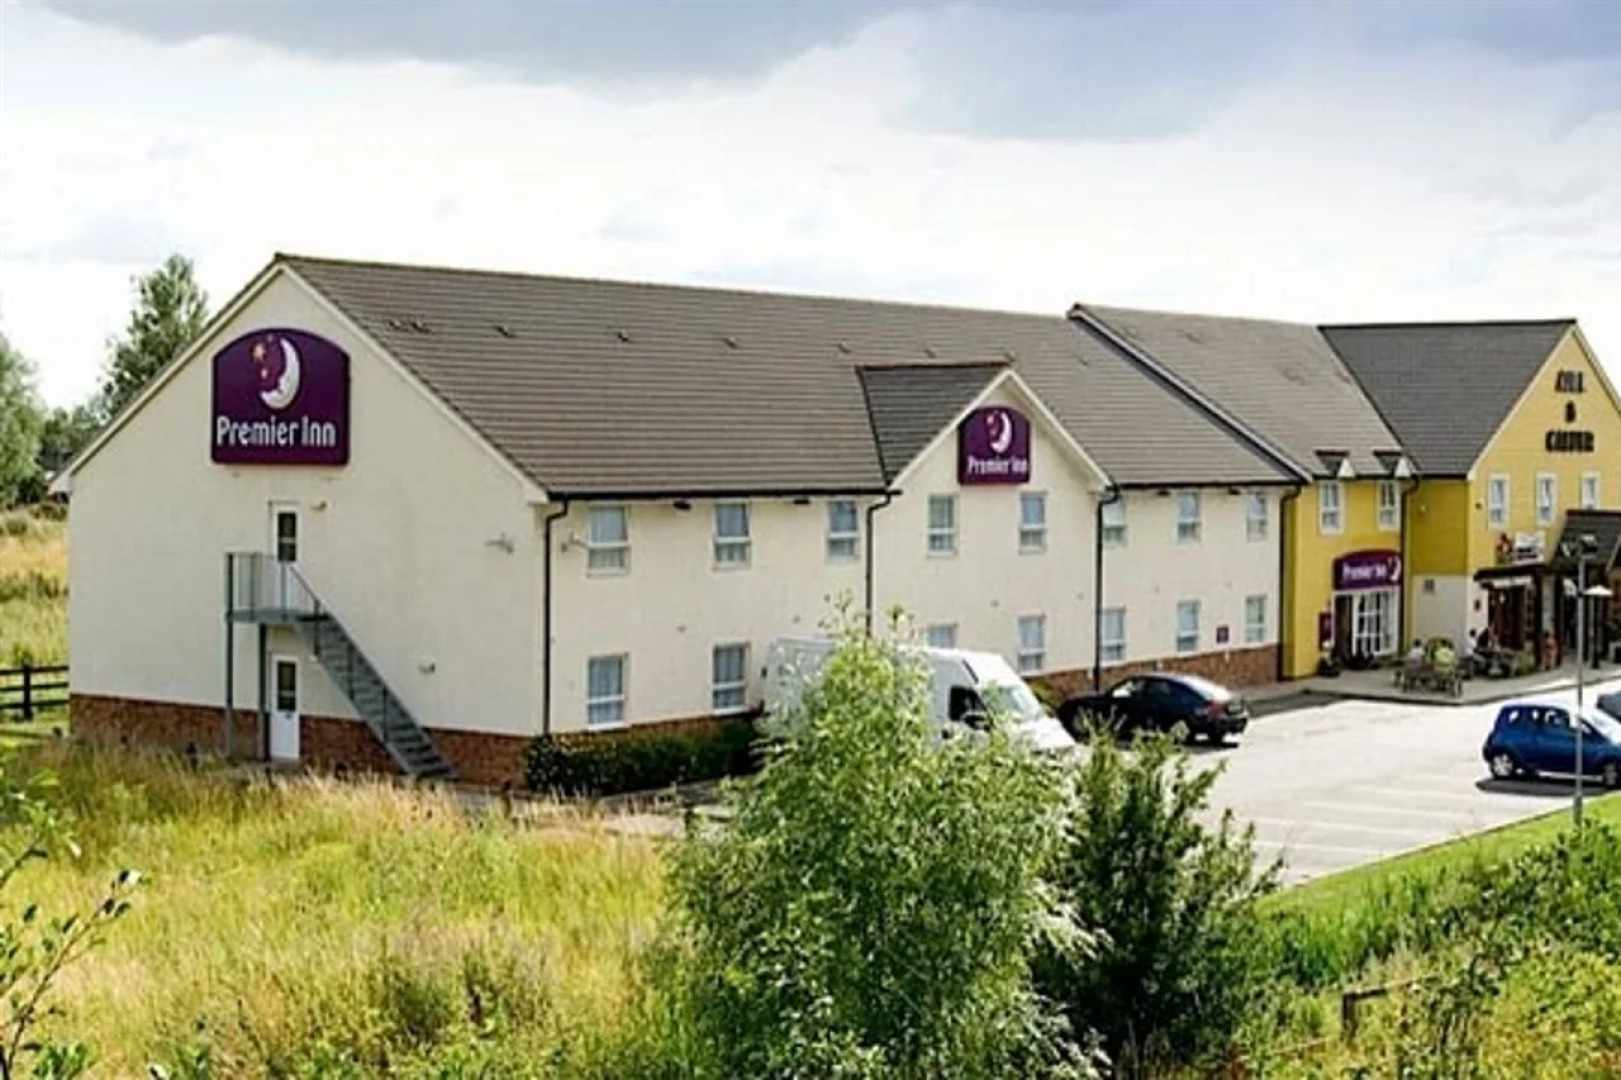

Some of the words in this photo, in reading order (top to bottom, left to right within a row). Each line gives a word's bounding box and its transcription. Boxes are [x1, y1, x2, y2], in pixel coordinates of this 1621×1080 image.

[217, 415, 299, 446] Premier
[302, 415, 336, 446] Inn
[967, 455, 1009, 475] Premier
